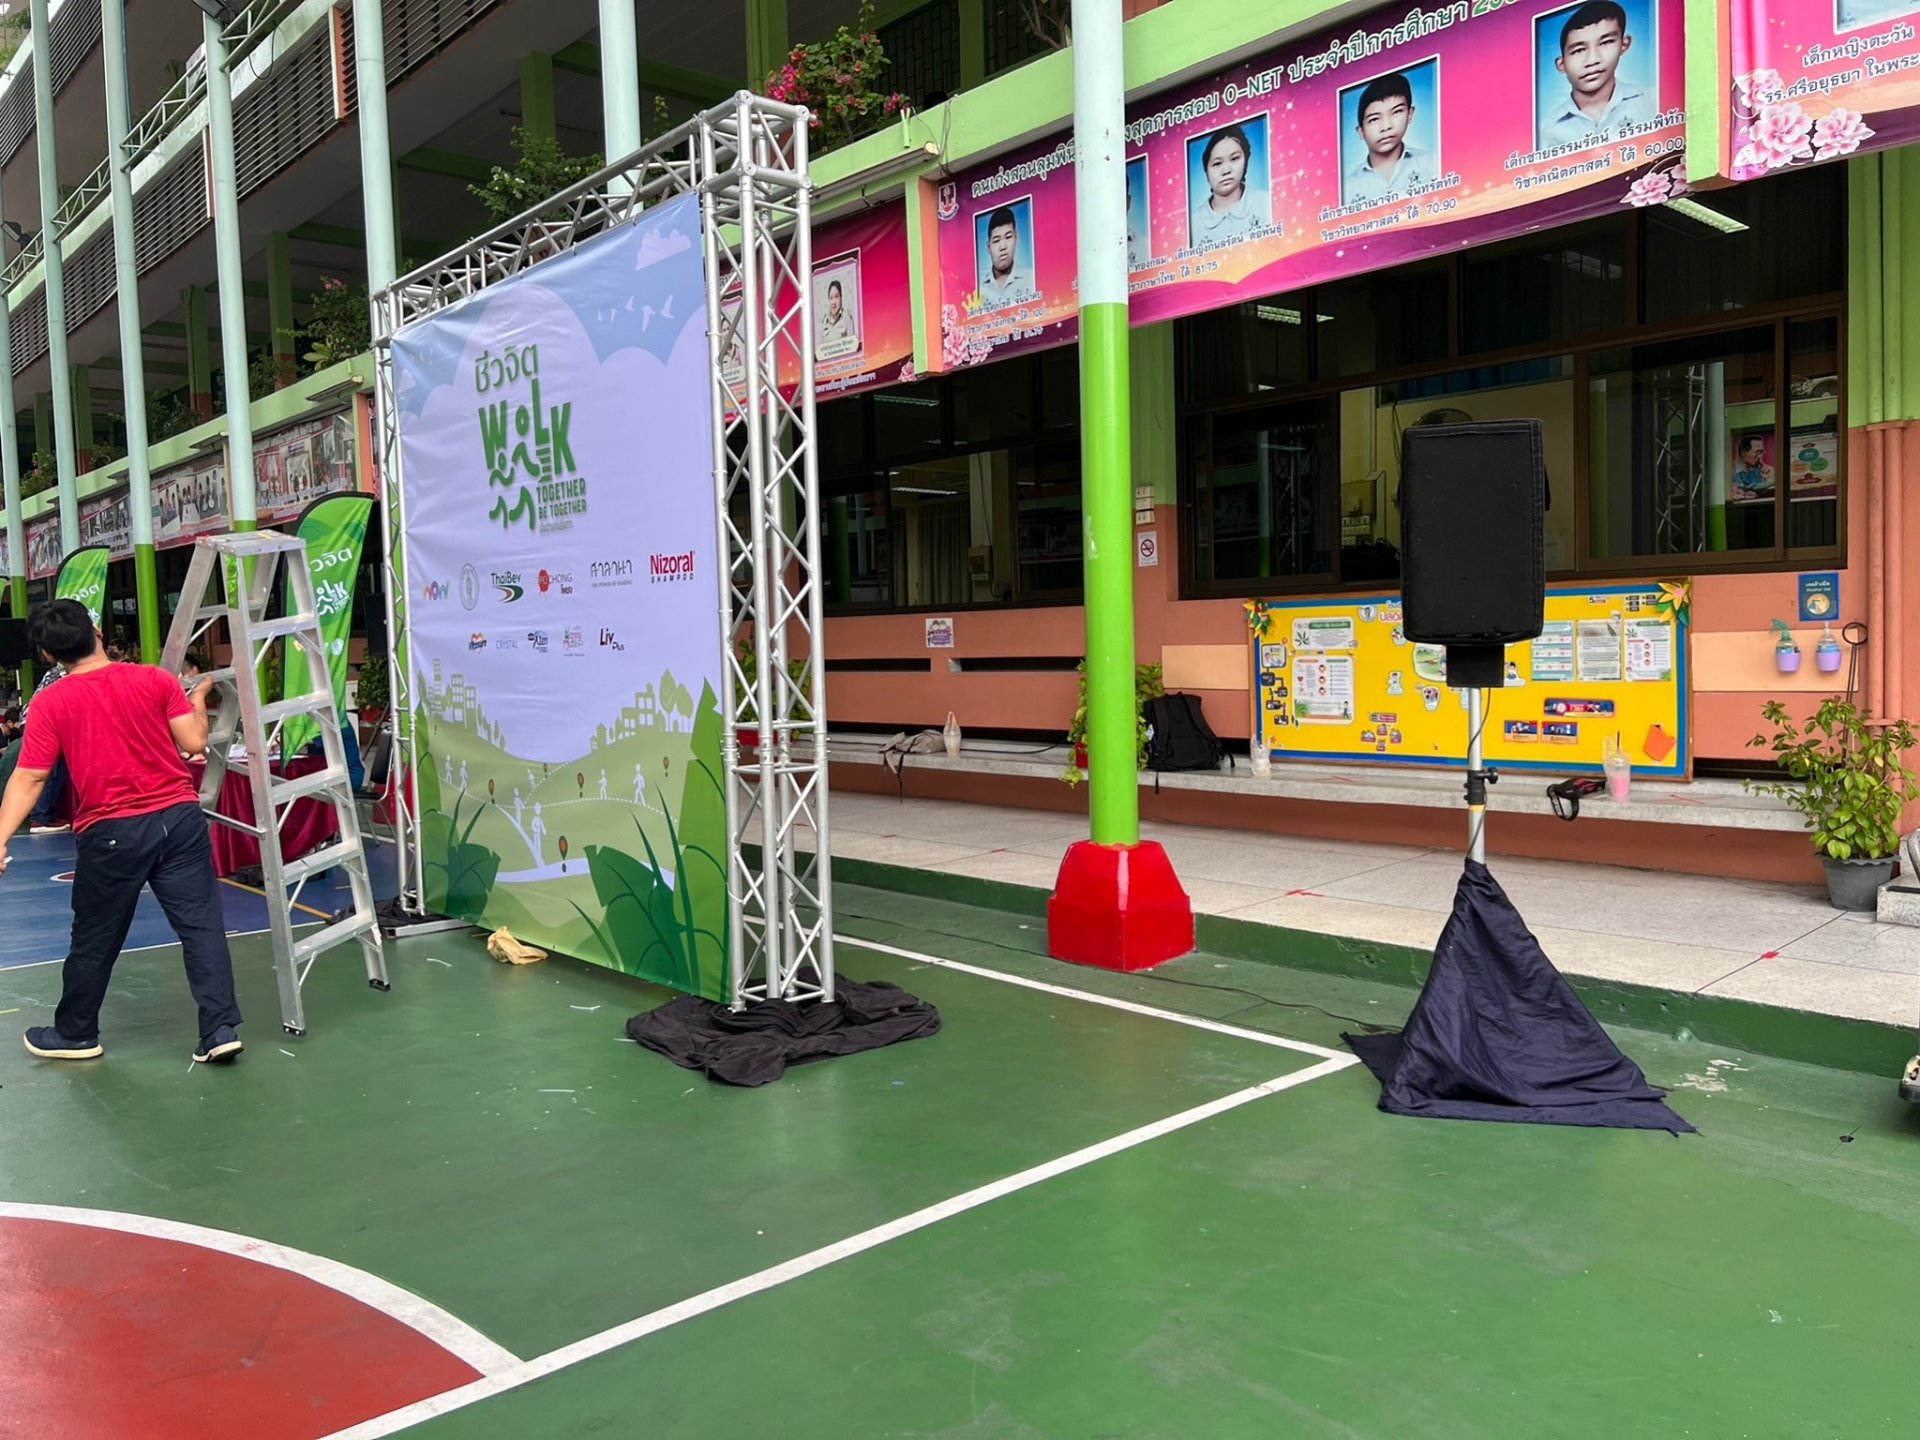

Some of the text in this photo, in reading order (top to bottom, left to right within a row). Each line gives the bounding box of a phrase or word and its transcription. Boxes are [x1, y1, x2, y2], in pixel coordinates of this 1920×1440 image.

[1803, 23, 1914, 68] เด็กหญิงตะวัน
[1125, 92, 1219, 148] งสุดการสอบ
[1224, 66, 1284, 105] O-NET
[1288, 0, 1469, 83] ประจำปีการศึกษา
[1764, 53, 1920, 103] รร.ศรีอยุธยา ในพระ
[1504, 108, 1687, 171] เด็กชายธรรมรัตน์ ธรรมพิทัก
[1515, 136, 1684, 190] วิชาคณิตศาสตร์ ได้ 60.00
[1321, 197, 1457, 242] วิชาวิทยาศาสตร์ ได้ 70.90
[475, 344, 538, 393] ชีวจิต
[536, 477, 586, 503] TOGETHER
[538, 499, 587, 519] BE TOGETHER
[490, 571, 522, 586] ThaiBev
[650, 550, 694, 575] Nizoral
[651, 573, 694, 584] SHAMPOO
[496, 639, 519, 650] CRYSTAL
[599, 628, 615, 646] Liv
